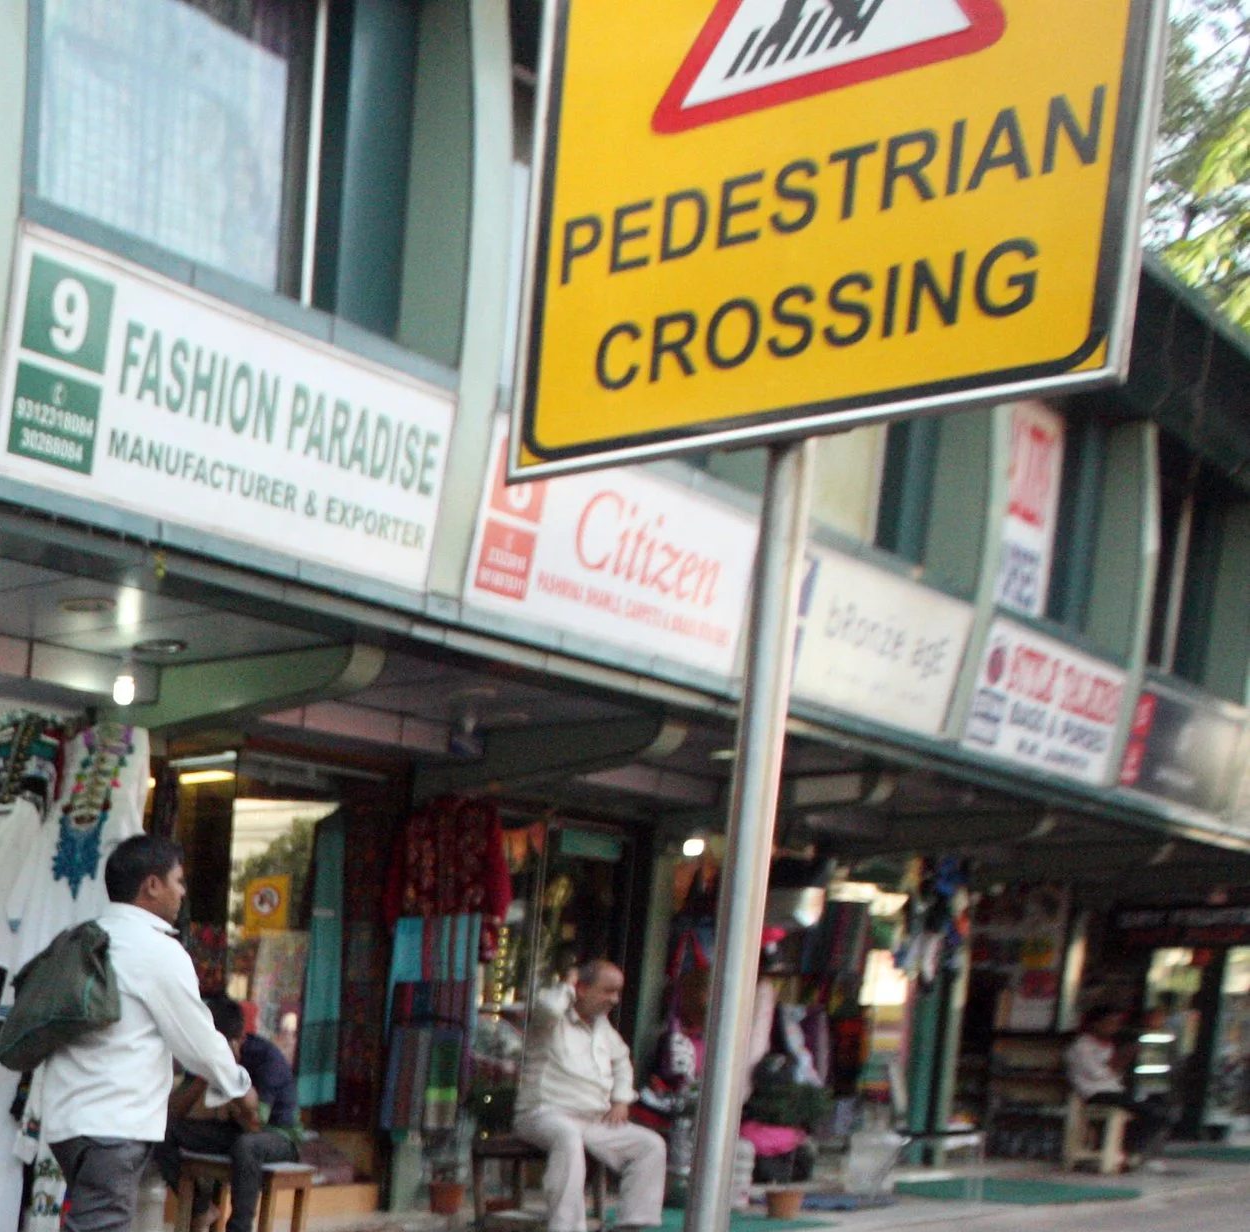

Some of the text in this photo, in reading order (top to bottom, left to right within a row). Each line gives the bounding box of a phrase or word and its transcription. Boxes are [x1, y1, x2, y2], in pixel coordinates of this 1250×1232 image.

[559, 83, 1107, 286] PEDESTRIAN
[49, 278, 89, 354] 9
[595, 237, 1039, 392] CROSSING
[119, 320, 441, 497] FASHION PARADISE
[107, 427, 427, 550] MANUFACTURER & EXPORTER
[575, 489, 722, 607] Citizen
